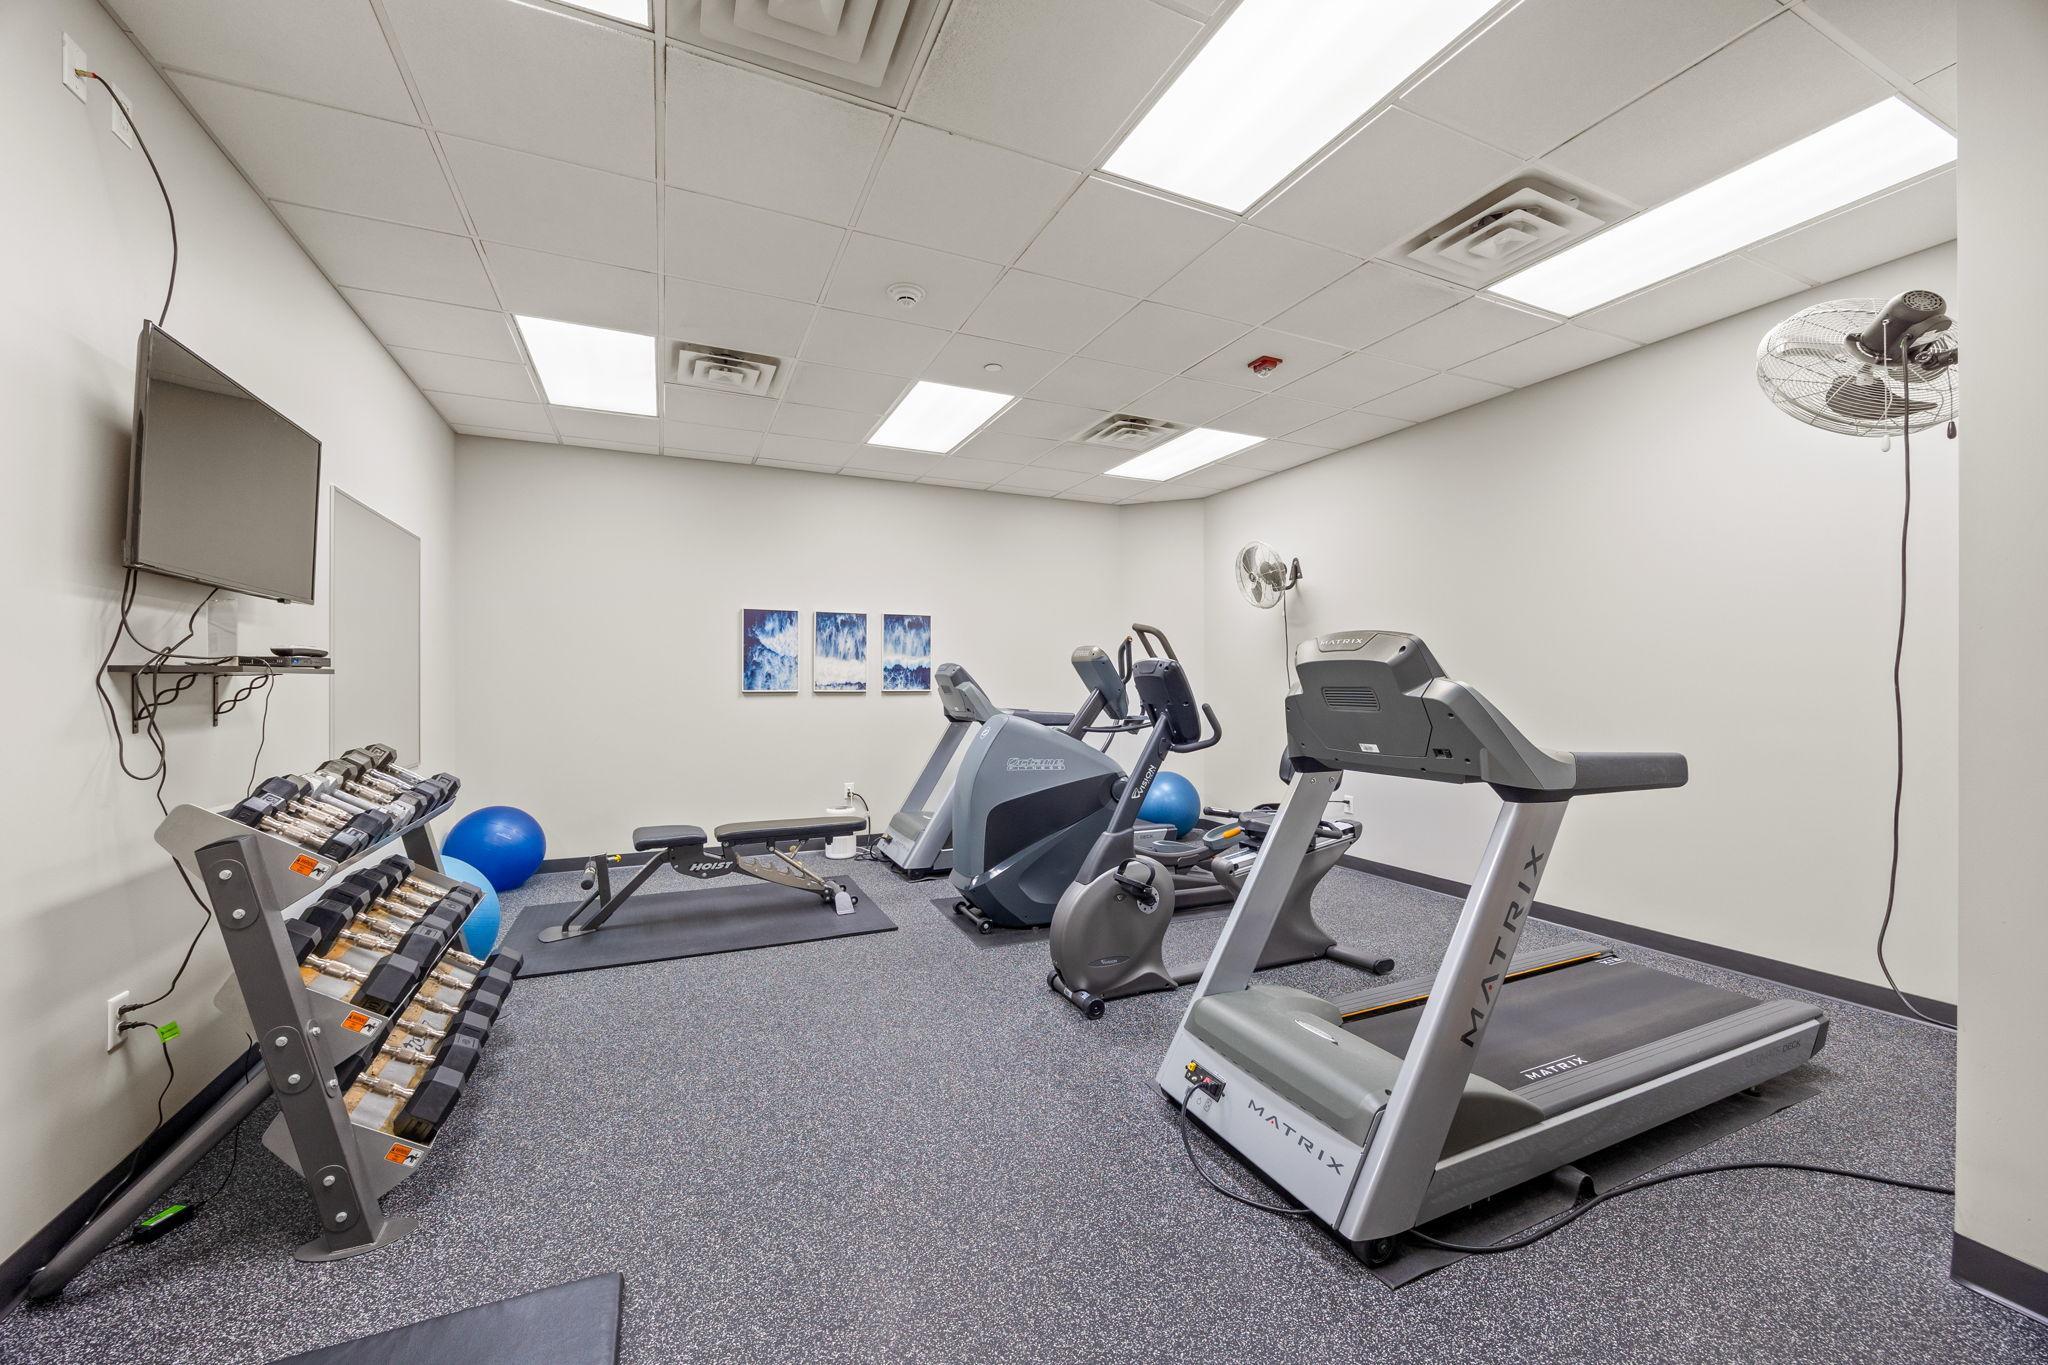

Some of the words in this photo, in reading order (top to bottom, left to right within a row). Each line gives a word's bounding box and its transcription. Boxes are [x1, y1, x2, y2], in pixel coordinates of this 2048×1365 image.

[1320, 638, 1363, 646] MATRIX
[1138, 764, 1157, 794] VISION
[689, 861, 734, 871] HOIST
[1460, 845, 1545, 1048] MATRIX
[1782, 1040, 1802, 1054] DECK
[1524, 1056, 1588, 1080] MATRIX
[1247, 1098, 1345, 1176] MATRIX
